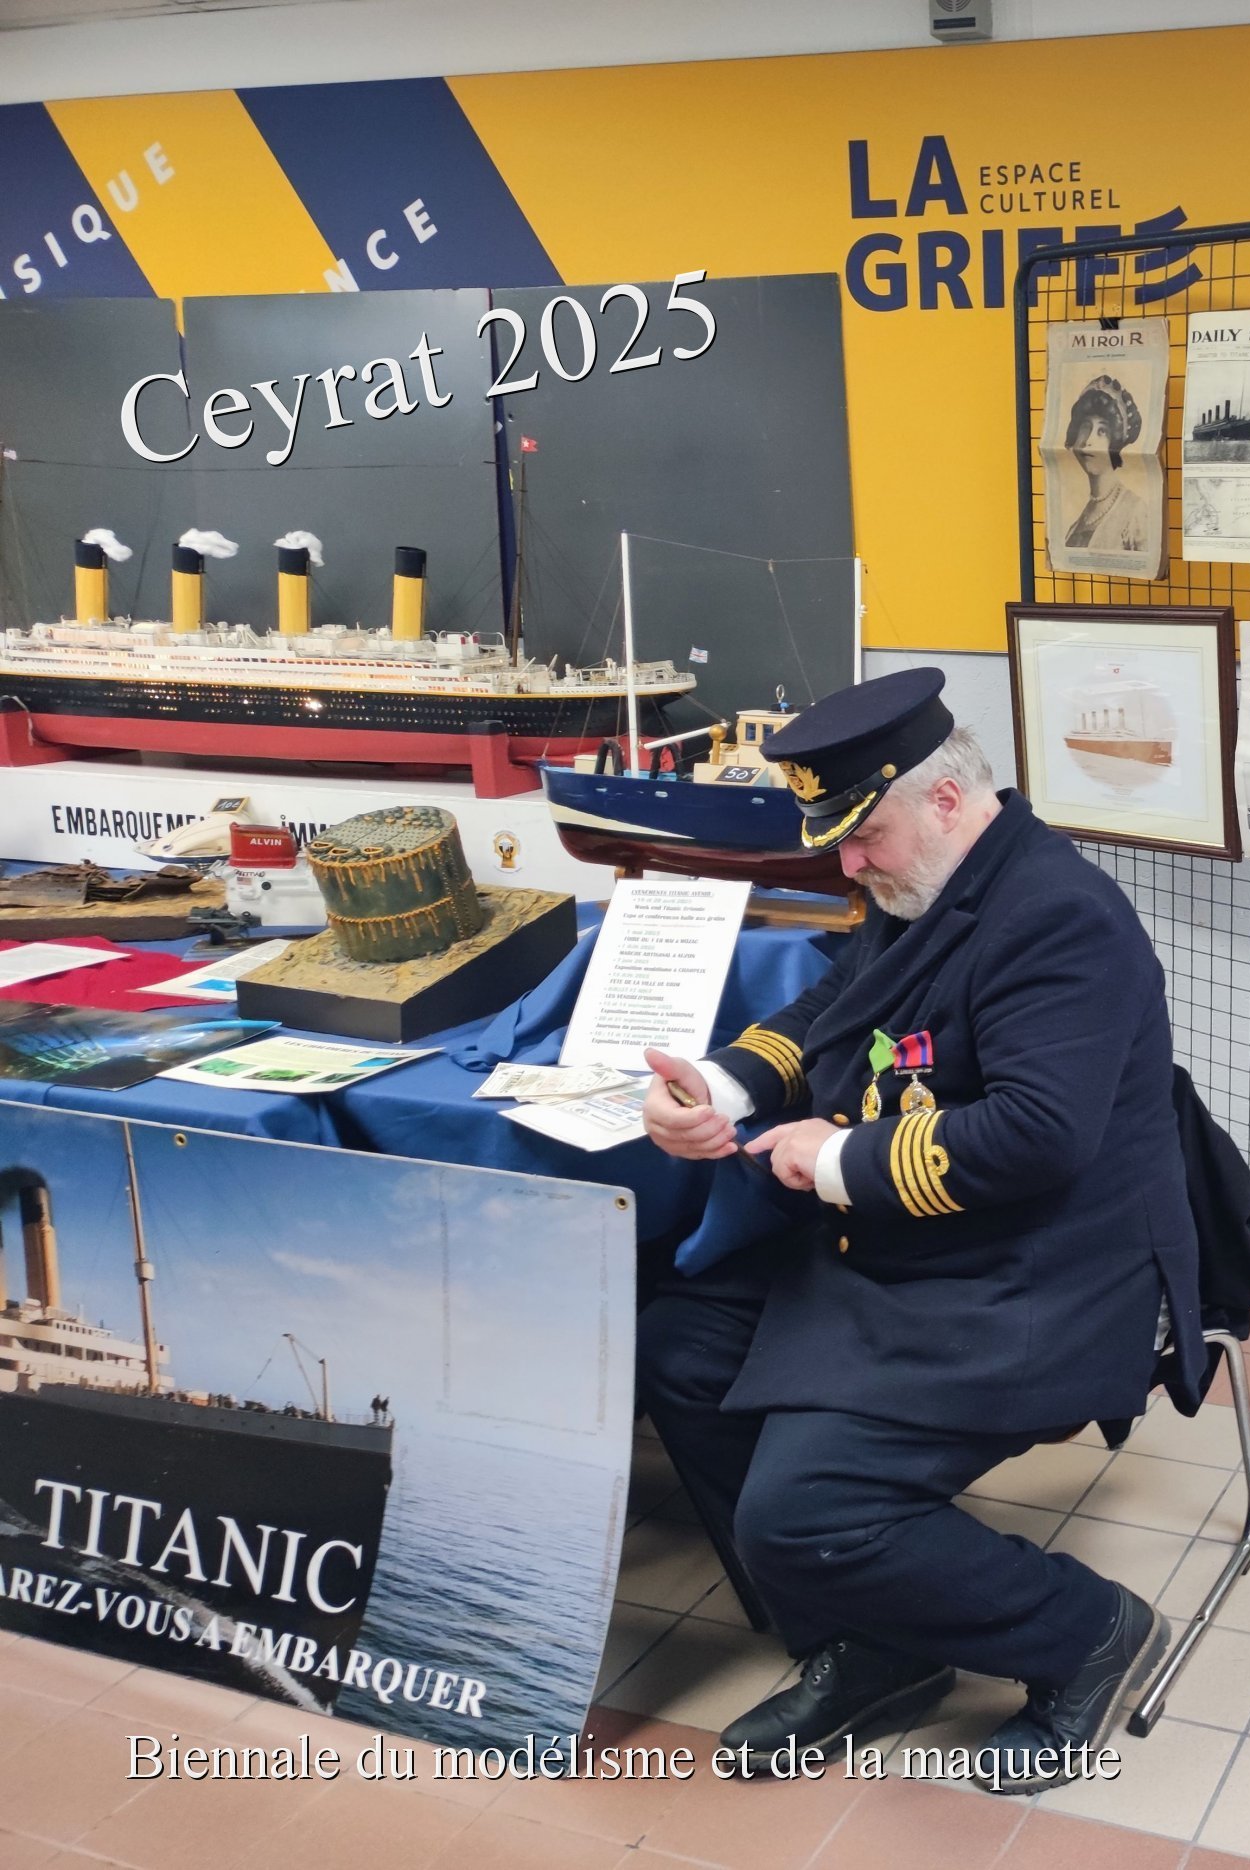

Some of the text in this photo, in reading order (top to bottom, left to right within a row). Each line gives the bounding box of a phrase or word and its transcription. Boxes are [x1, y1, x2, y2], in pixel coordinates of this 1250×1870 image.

[848, 135, 968, 219] LA
[980, 161, 1082, 187] ESPACE
[980, 188, 1121, 215] CULTUREL
[0, 142, 175, 299] SIQUE
[322, 198, 438, 292] NCE
[845, 205, 1204, 312] GRIFFE
[1072, 331, 1144, 348] MIROIR
[1192, 328, 1242, 344] DAILY
[52, 805, 205, 842] EMBARQUEM
[250, 837, 282, 846] ALVIN
[34, 1478, 364, 1614] TITANIC
[0, 1563, 488, 1719] REZ-VOUS A EMBARQUER
